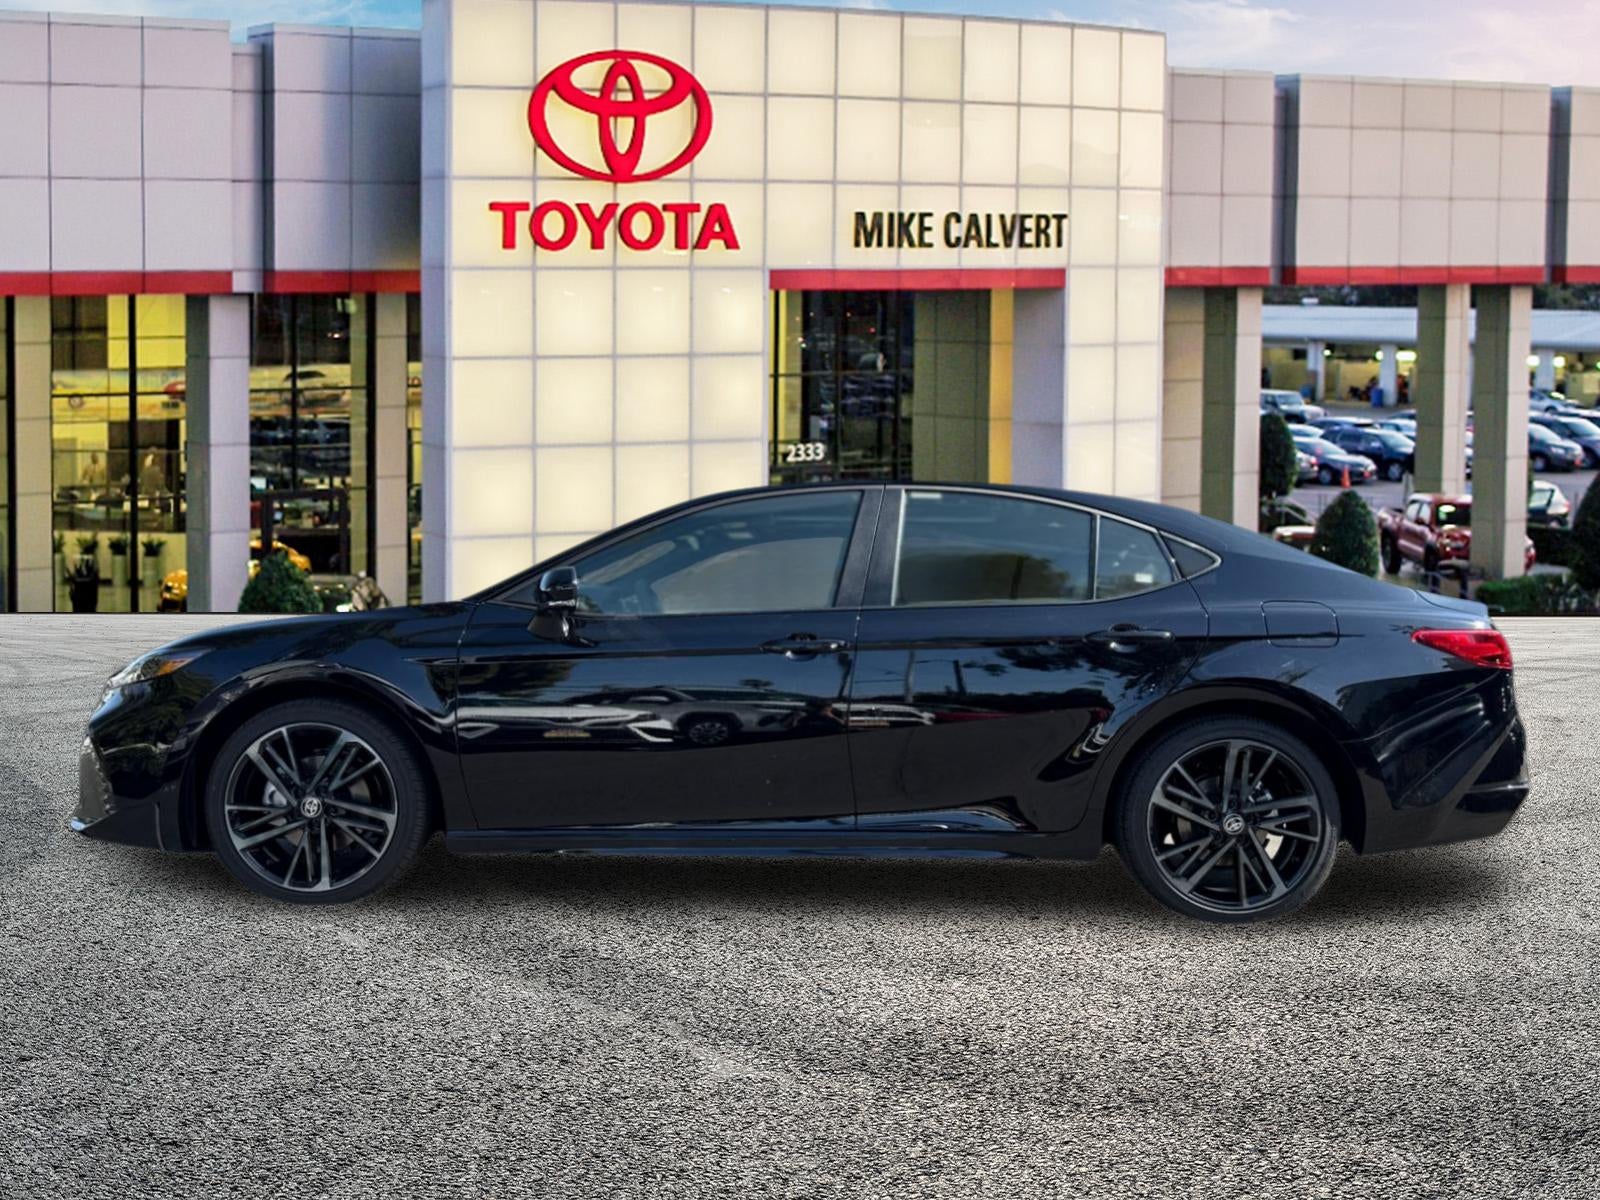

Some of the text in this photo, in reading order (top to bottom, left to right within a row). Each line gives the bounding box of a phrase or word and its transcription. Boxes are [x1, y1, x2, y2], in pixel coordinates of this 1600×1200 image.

[489, 201, 740, 251] TOYOTA
[854, 211, 1069, 249] MIKE CALVERT
[786, 442, 825, 462] 2333
